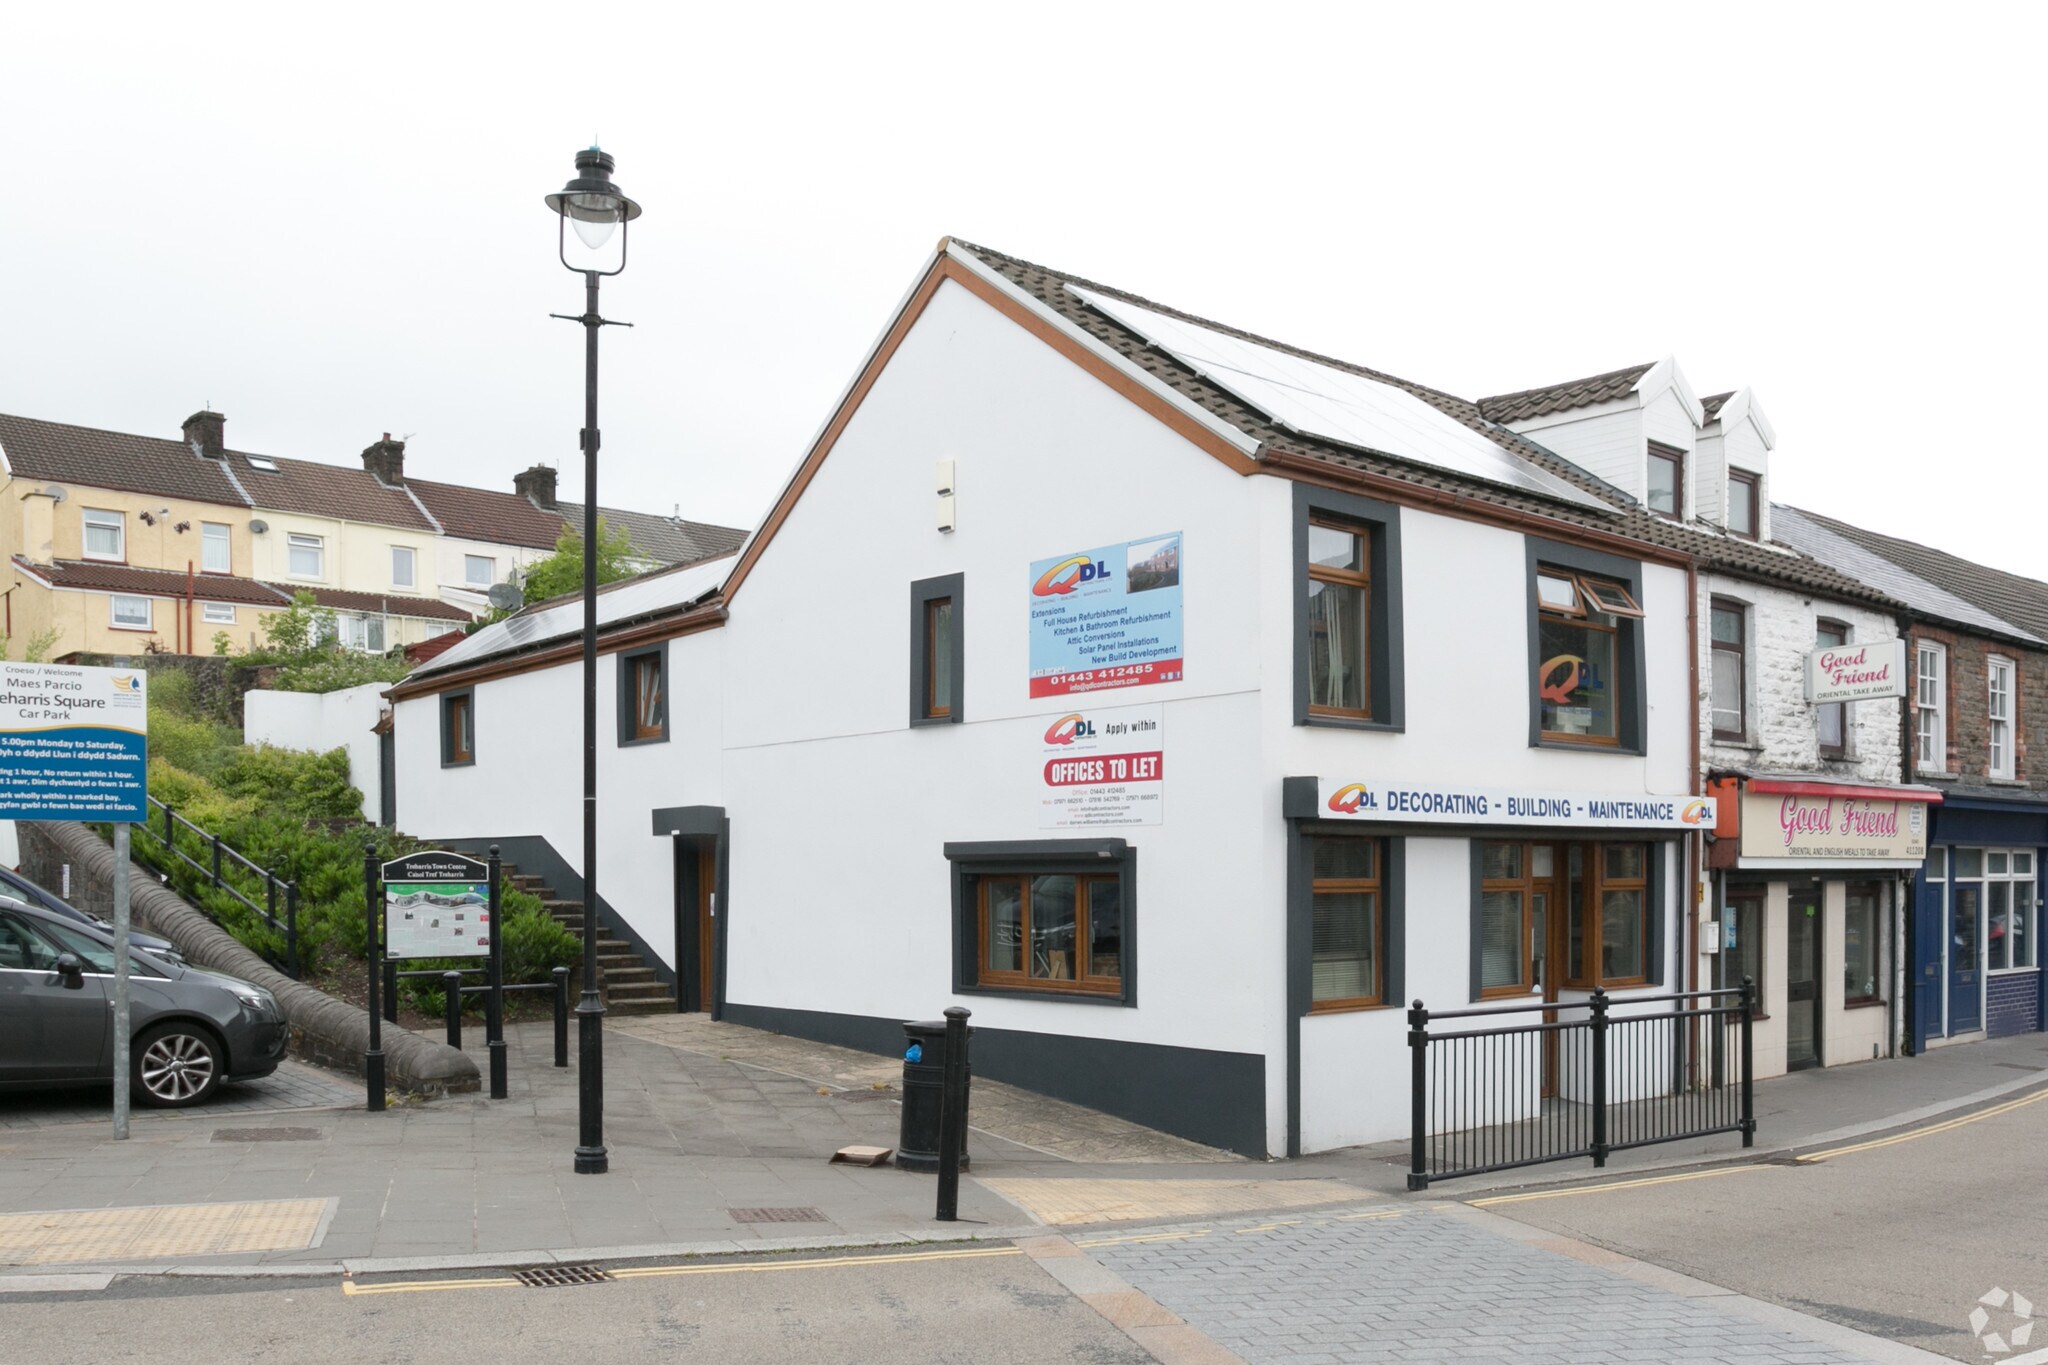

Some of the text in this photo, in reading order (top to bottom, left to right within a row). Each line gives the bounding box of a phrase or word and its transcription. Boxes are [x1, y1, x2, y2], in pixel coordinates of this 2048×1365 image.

[1032, 556, 1110, 596] QDL
[1032, 606, 1066, 618] Extensions
[1044, 607, 1128, 628] Full House Refurbishment
[1054, 611, 1171, 636] Kitchen & Bathroom Refurbishment
[1067, 630, 1126, 646] Attic Conversions
[1079, 637, 1159, 654] Solar Panel Installations
[1092, 646, 1177, 664] New Build Development
[1820, 648, 1866, 674] Good
[5, 666, 35, 674] Croeso
[44, 668, 83, 677] Welcome
[1050, 664, 1154, 685] 01443 412485
[1831, 664, 1890, 686] Friend
[7, 678, 82, 690] Maes Parcio
[1817, 690, 1851, 699] ORIENTAL
[1872, 685, 1894, 694] AWAY
[54, 694, 106, 710] Square
[19, 708, 71, 720] Car Park
[1044, 713, 1156, 745] QDL Apply within
[2, 738, 35, 748] 5.00pm
[37, 739, 73, 750] Monday
[86, 741, 126, 750] Saturday.
[23, 750, 51, 760] ddydd
[78, 752, 104, 760] ddydd
[107, 752, 140, 760] Sadwrn.
[115, 770, 134, 778] hour.
[1052, 757, 1157, 784] OFFICES TO LET
[49, 779, 90, 788] dychwelyd
[14, 792, 40, 800] wholly
[1328, 783, 1378, 814] QDL
[1387, 790, 1488, 815] DECORATING
[1508, 797, 1571, 818] BUILDING
[1588, 801, 1674, 820] MAINTENANCE
[1681, 800, 1712, 824] QDL
[1780, 794, 1833, 846] Good
[1840, 798, 1898, 837] Friend
[1789, 846, 1812, 856] ORIENTAL
[1813, 847, 1824, 856] AND
[1824, 848, 1844, 856] ENGLISH
[1844, 848, 1859, 856] MEALS
[1860, 848, 1866, 856] TO
[1866, 848, 1876, 856] TAKE
